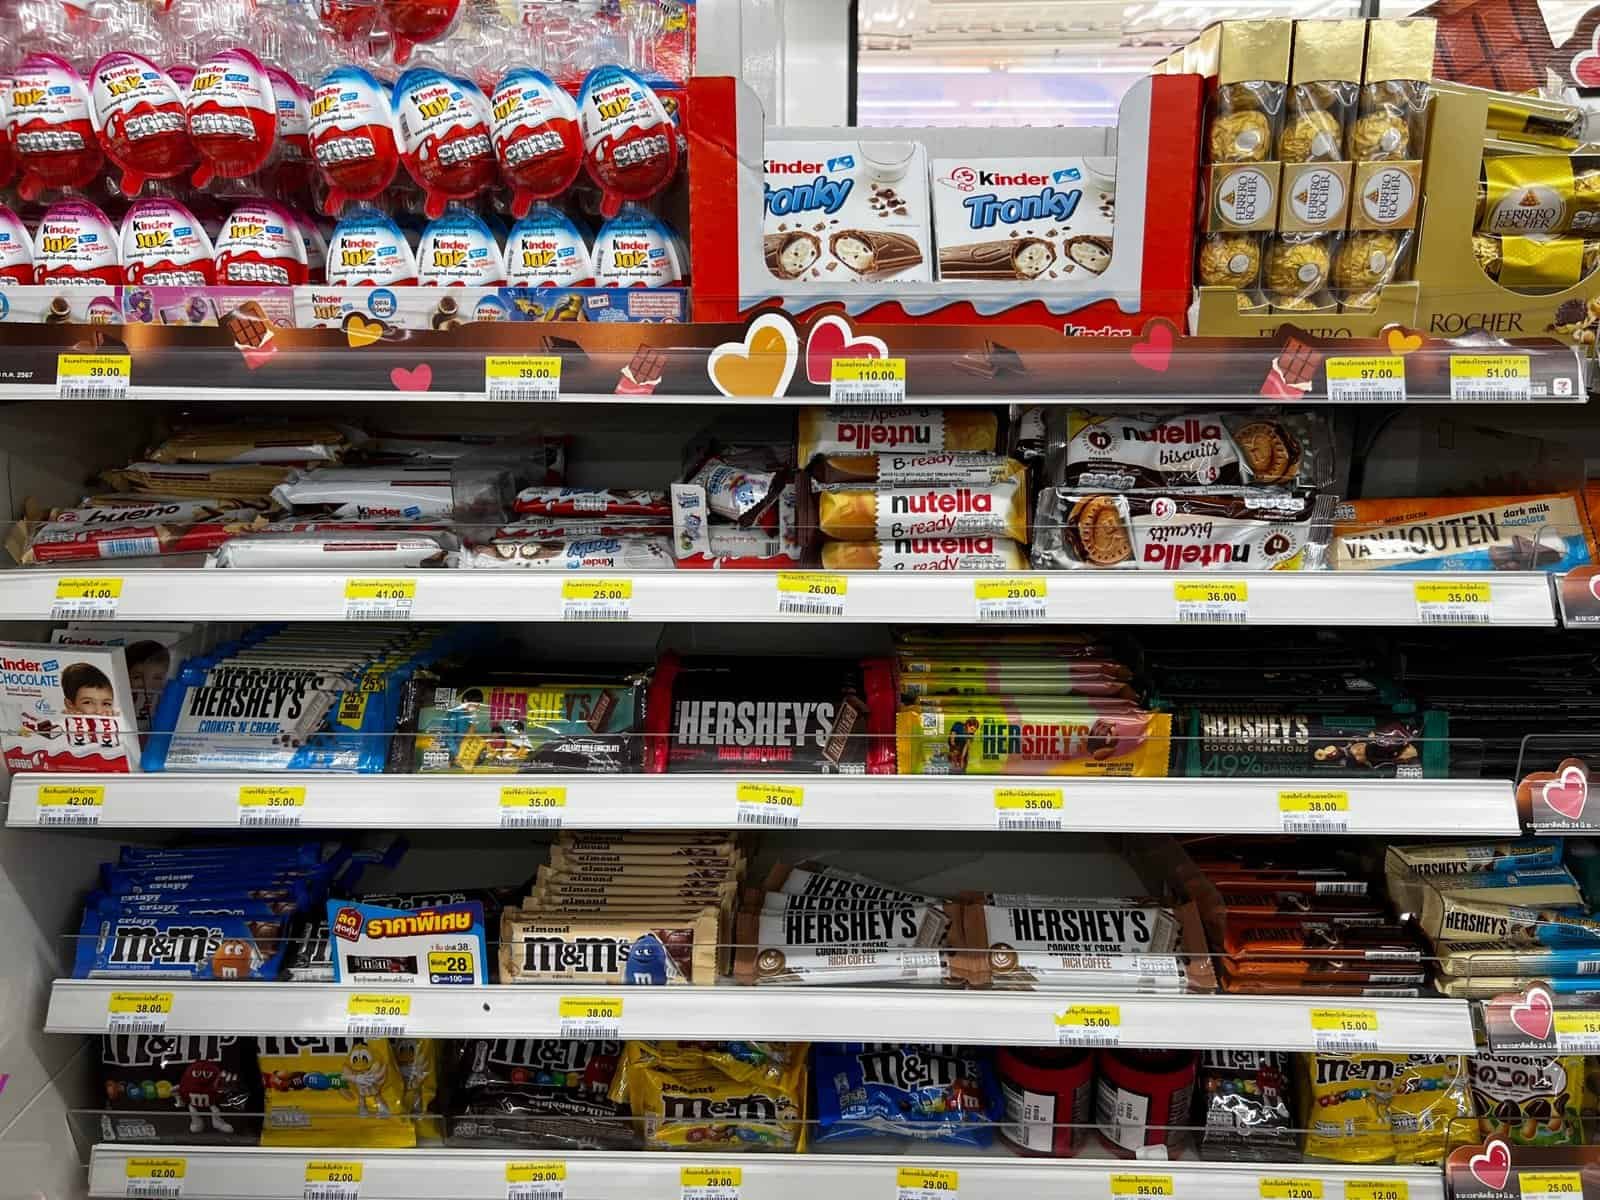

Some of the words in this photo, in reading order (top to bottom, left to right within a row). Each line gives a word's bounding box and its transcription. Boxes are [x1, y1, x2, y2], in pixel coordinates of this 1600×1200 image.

[99, 67, 140, 83] Kinder
[411, 87, 449, 106] Kinder
[593, 86, 630, 106] Kinder
[979, 170, 1049, 187] Kinder
[764, 176, 854, 216] ronky
[1236, 175, 1247, 220] FERRERO
[1246, 175, 1257, 220] ROCHER
[1307, 174, 1320, 219] FERRERO
[1318, 175, 1330, 219] ROCHER
[1379, 174, 1391, 218] FERRERO
[1389, 175, 1400, 218] ROCHER
[963, 188, 1081, 229] Tronky
[1497, 208, 1556, 220] FERRERO
[133, 219, 173, 231] Kinder
[230, 214, 269, 226] Kinder
[42, 221, 80, 235] Kinder
[340, 238, 378, 249] Kinder
[432, 239, 470, 250] Kinder
[521, 240, 558, 250] Kinder
[612, 240, 650, 251] Kinder
[312, 294, 342, 304] Kinder
[1430, 312, 1523, 332] ROCHER
[90, 367, 120, 377] 39.00
[519, 368, 549, 378] 39.00
[858, 370, 895, 381] 110.00
[1361, 369, 1392, 379] 97.00
[1486, 368, 1518, 378] 51.00
[838, 423, 931, 450] nutella
[1122, 419, 1221, 444] nutella
[1159, 441, 1220, 466] biscuits
[892, 488, 992, 513] nutella
[83, 505, 180, 526] bueno
[1503, 507, 1526, 518] dark
[1528, 503, 1550, 514] milk
[1150, 522, 1213, 542] biscuits
[895, 537, 993, 554] nutella
[1143, 544, 1250, 569] nutella
[82, 589, 111, 599] 41.00
[376, 590, 404, 599] 41.00
[593, 590, 622, 599] 25.00
[808, 584, 837, 595] 26.00
[1008, 589, 1036, 598] 29.00
[1207, 592, 1236, 602] 36.00
[1448, 593, 1478, 602] 35.00
[190, 686, 305, 719] HERSHEY'S
[198, 720, 234, 734] COOKIES
[250, 721, 280, 734] CREME
[678, 700, 835, 747] HERSHEY'S
[1203, 714, 1309, 745] HERSHEY'S
[983, 724, 1089, 755] HERSHEY'S
[718, 746, 742, 760] DARK
[744, 746, 792, 761] CHOCOLATE
[1201, 754, 1261, 776] 49%
[67, 797, 94, 806] 42.00
[267, 797, 295, 807] 35.00
[528, 798, 556, 807] 35.00
[765, 796, 793, 806] 35.00
[1025, 800, 1053, 809] 35.00
[1309, 802, 1337, 812] 38.00
[118, 918, 158, 926] crispy
[339, 912, 355, 925] ลด
[367, 911, 472, 937] ราคาพิเศษ
[1446, 911, 1508, 936] HERSHEY'S
[786, 909, 917, 945] HERSHEY'S
[1015, 909, 1150, 943] HERSHEY'S
[1047, 943, 1081, 957] COOKIES
[1094, 944, 1123, 957] CREME
[447, 957, 467, 972] 28
[828, 955, 846, 968] RICH
[847, 954, 876, 966] COFFEE
[1062, 957, 1081, 969] RICH
[1082, 957, 1112, 969] COFFEE
[136, 1004, 161, 1013] 38.00
[375, 1006, 400, 1016] 38.00
[586, 1008, 613, 1018] 38.00
[1083, 1017, 1110, 1027] 35.00
[1341, 1021, 1368, 1031] 15.00
[1584, 1024, 1600, 1033] 15.
[150, 1168, 176, 1178] 62.00
[328, 1173, 353, 1182] 62.00
[532, 1172, 557, 1182] 29.00
[707, 1177, 732, 1187] 29.00
[923, 1180, 948, 1190] 29.00
[1547, 1183, 1574, 1193] 25.00
[1137, 1186, 1163, 1196] 95.00
[1287, 1190, 1313, 1199] 12.00
[1372, 1191, 1397, 1200] 12.00
